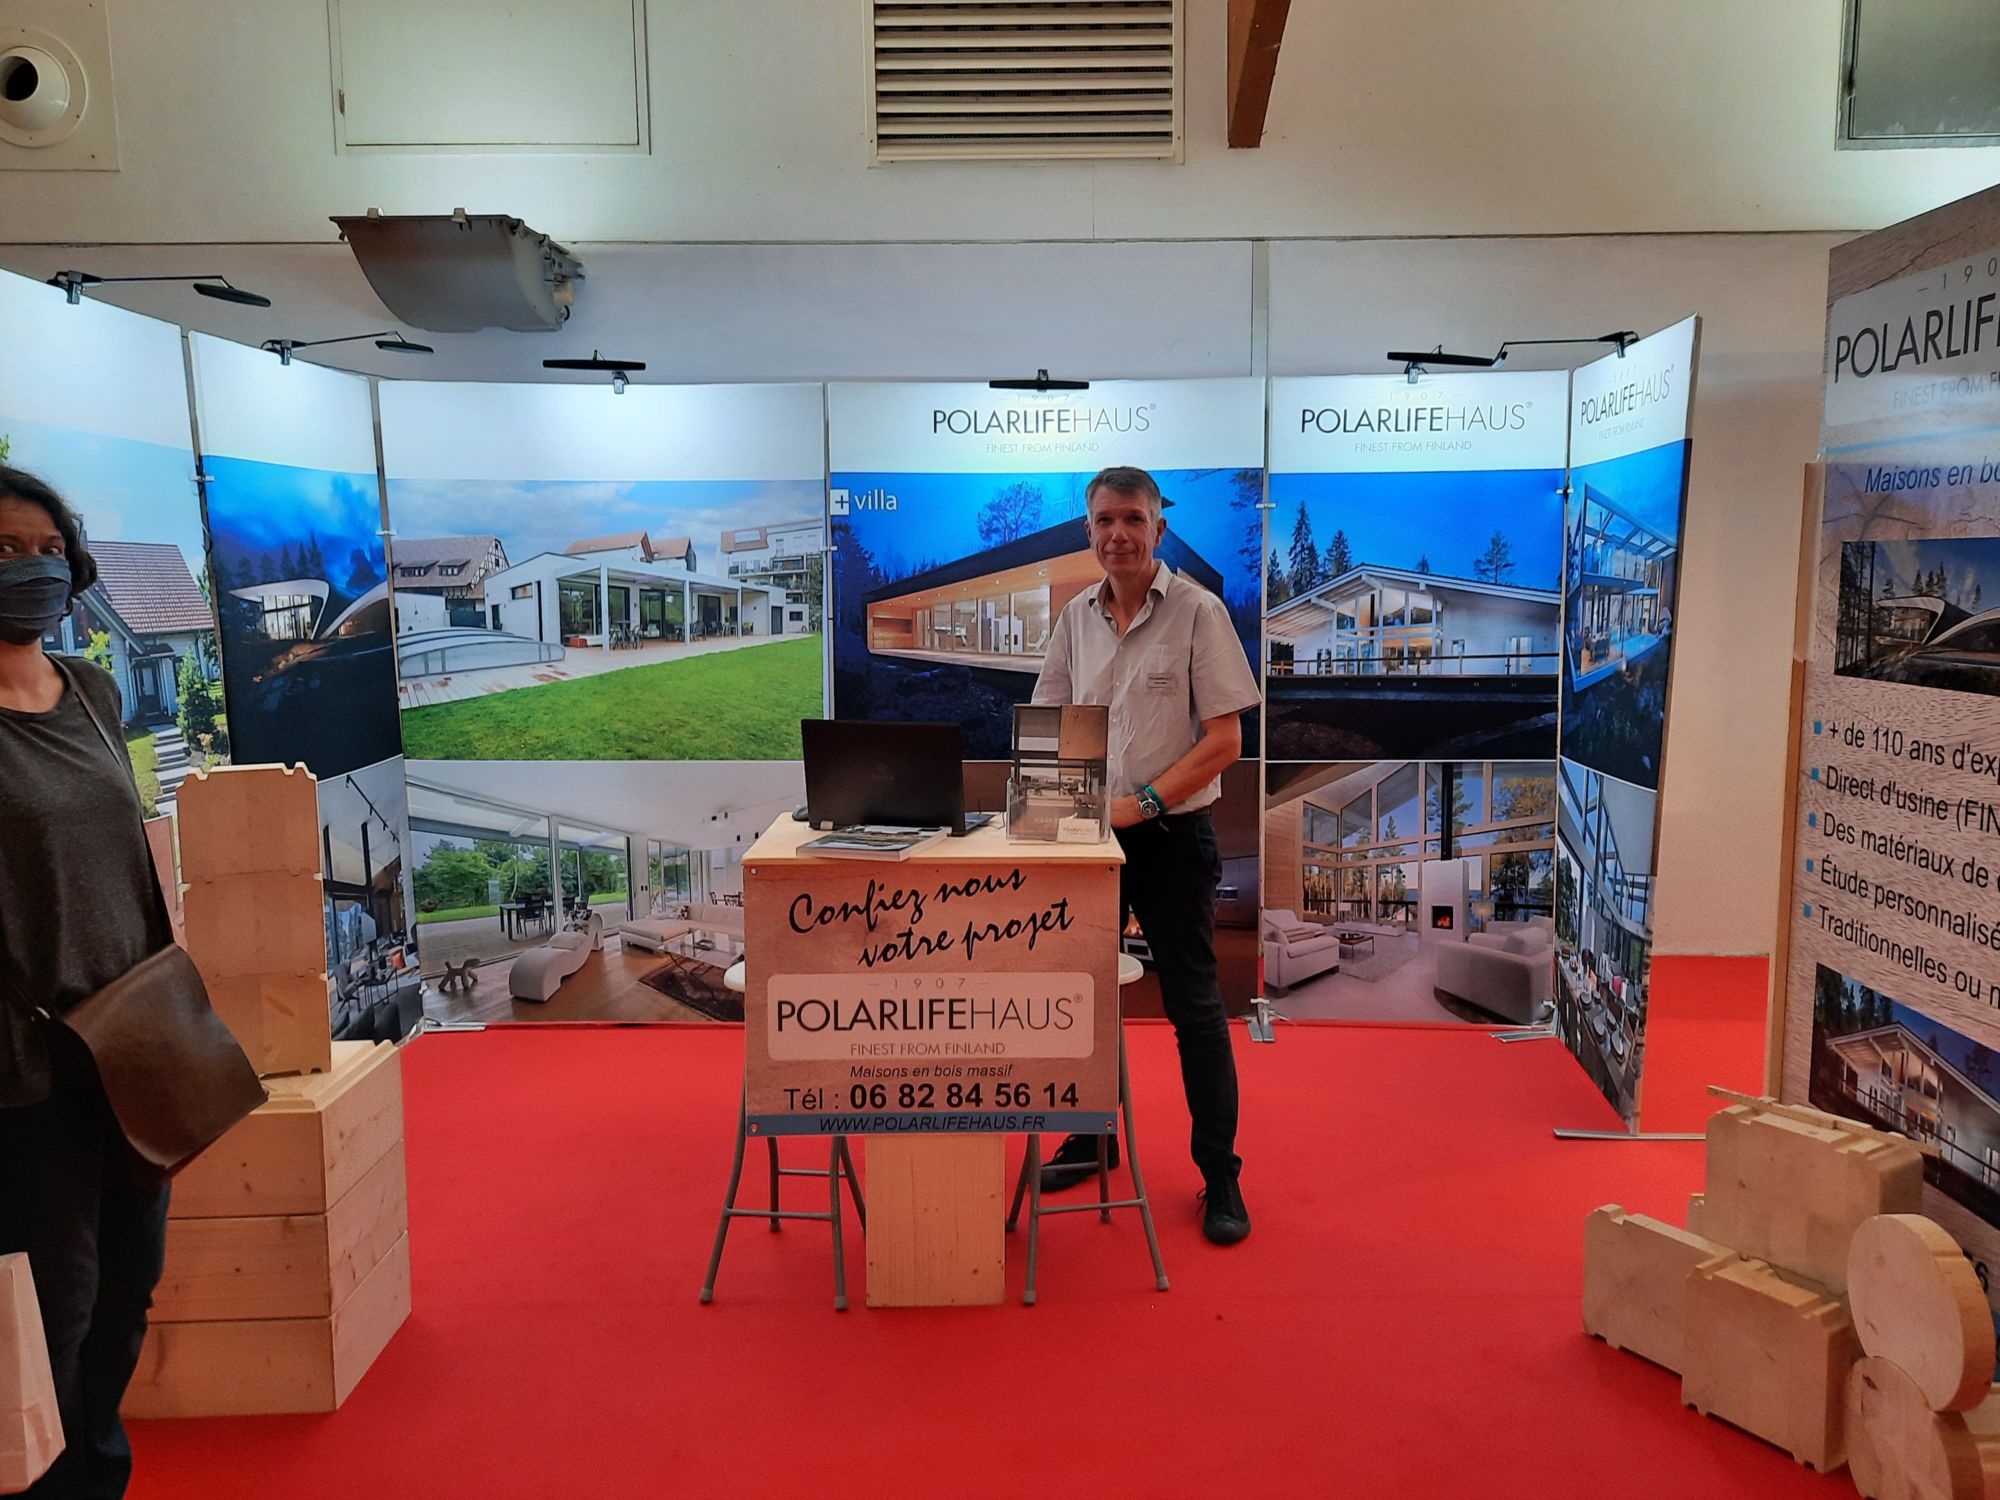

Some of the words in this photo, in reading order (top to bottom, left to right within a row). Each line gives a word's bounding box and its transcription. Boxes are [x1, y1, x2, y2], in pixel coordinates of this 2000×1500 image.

[1941, 375, 1984, 399] FROM
[986, 443, 1018, 454] FINEST
[1022, 443, 1051, 454] FROM
[1055, 442, 1099, 453] FINLAND
[1355, 442, 1388, 453] FINEST
[1392, 441, 1422, 452] FROM
[1426, 440, 1472, 451] FINLAND
[1865, 467, 1941, 493] Maisons
[1948, 464, 1973, 487] en
[854, 488, 898, 511] villa
[1844, 721, 1866, 749] de
[1873, 726, 1903, 757] 110
[1909, 739, 1945, 766] ans
[1826, 764, 1876, 800] Direct
[1880, 780, 1949, 821] d'usine
[1823, 812, 1856, 845] Des
[1861, 823, 1955, 878] matériaux
[1961, 857, 1989, 888] de
[1820, 855, 1870, 900] Étude
[788, 878, 929, 934] Confiez
[932, 867, 1028, 903] nous
[857, 927, 955, 968] votre
[961, 896, 1075, 961] projet
[1819, 904, 1948, 984] Traditionnelles
[1954, 970, 1981, 1000] ou
[850, 1043, 896, 1056] FINEST
[900, 1043, 941, 1055] FROM
[945, 1042, 1006, 1055] FINLAND
[849, 1064, 908, 1079] Maisons
[912, 1068, 930, 1078] en
[933, 1064, 962, 1078] bois
[966, 1063, 1014, 1077] massif
[783, 1086, 824, 1111] Tél
[849, 1083, 888, 1109] 06
[898, 1083, 936, 1109] 82
[945, 1083, 984, 1108] 84
[993, 1083, 1032, 1108] 56
[1043, 1082, 1079, 1107] 14
[819, 1115, 1047, 1132] WWW.POLARLIFEHAUS.FR
